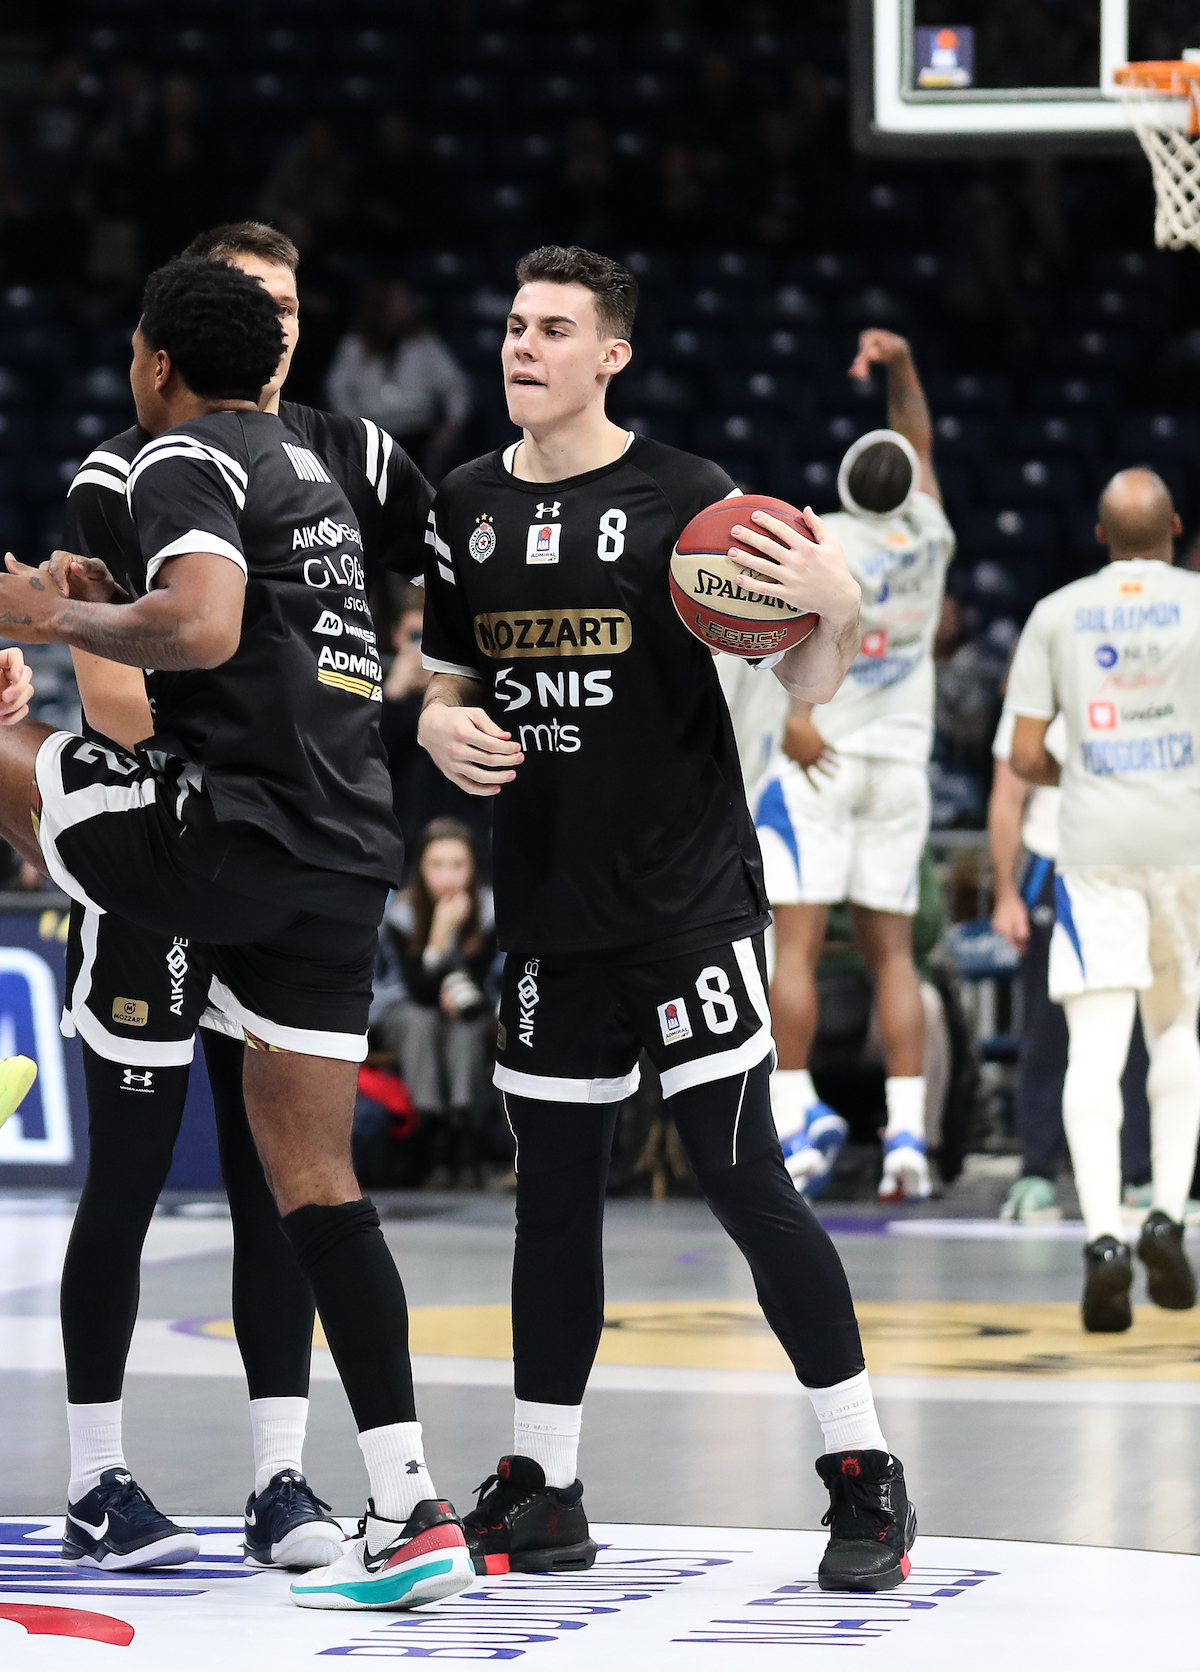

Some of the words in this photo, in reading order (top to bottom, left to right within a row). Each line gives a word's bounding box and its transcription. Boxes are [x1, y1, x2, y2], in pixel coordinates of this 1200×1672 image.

[292, 526, 323, 550] AIK
[597, 508, 628, 562] 8
[478, 617, 625, 650] MOZZART
[696, 613, 788, 643] LEGACY
[535, 670, 614, 708] NIS
[518, 718, 582, 752] mts
[170, 977, 184, 1016] AIK
[695, 966, 738, 1034] 8
[113, 1013, 146, 1023] MOZZART
[519, 1007, 535, 1048] AIK
[669, 1618, 911, 1647] NA
